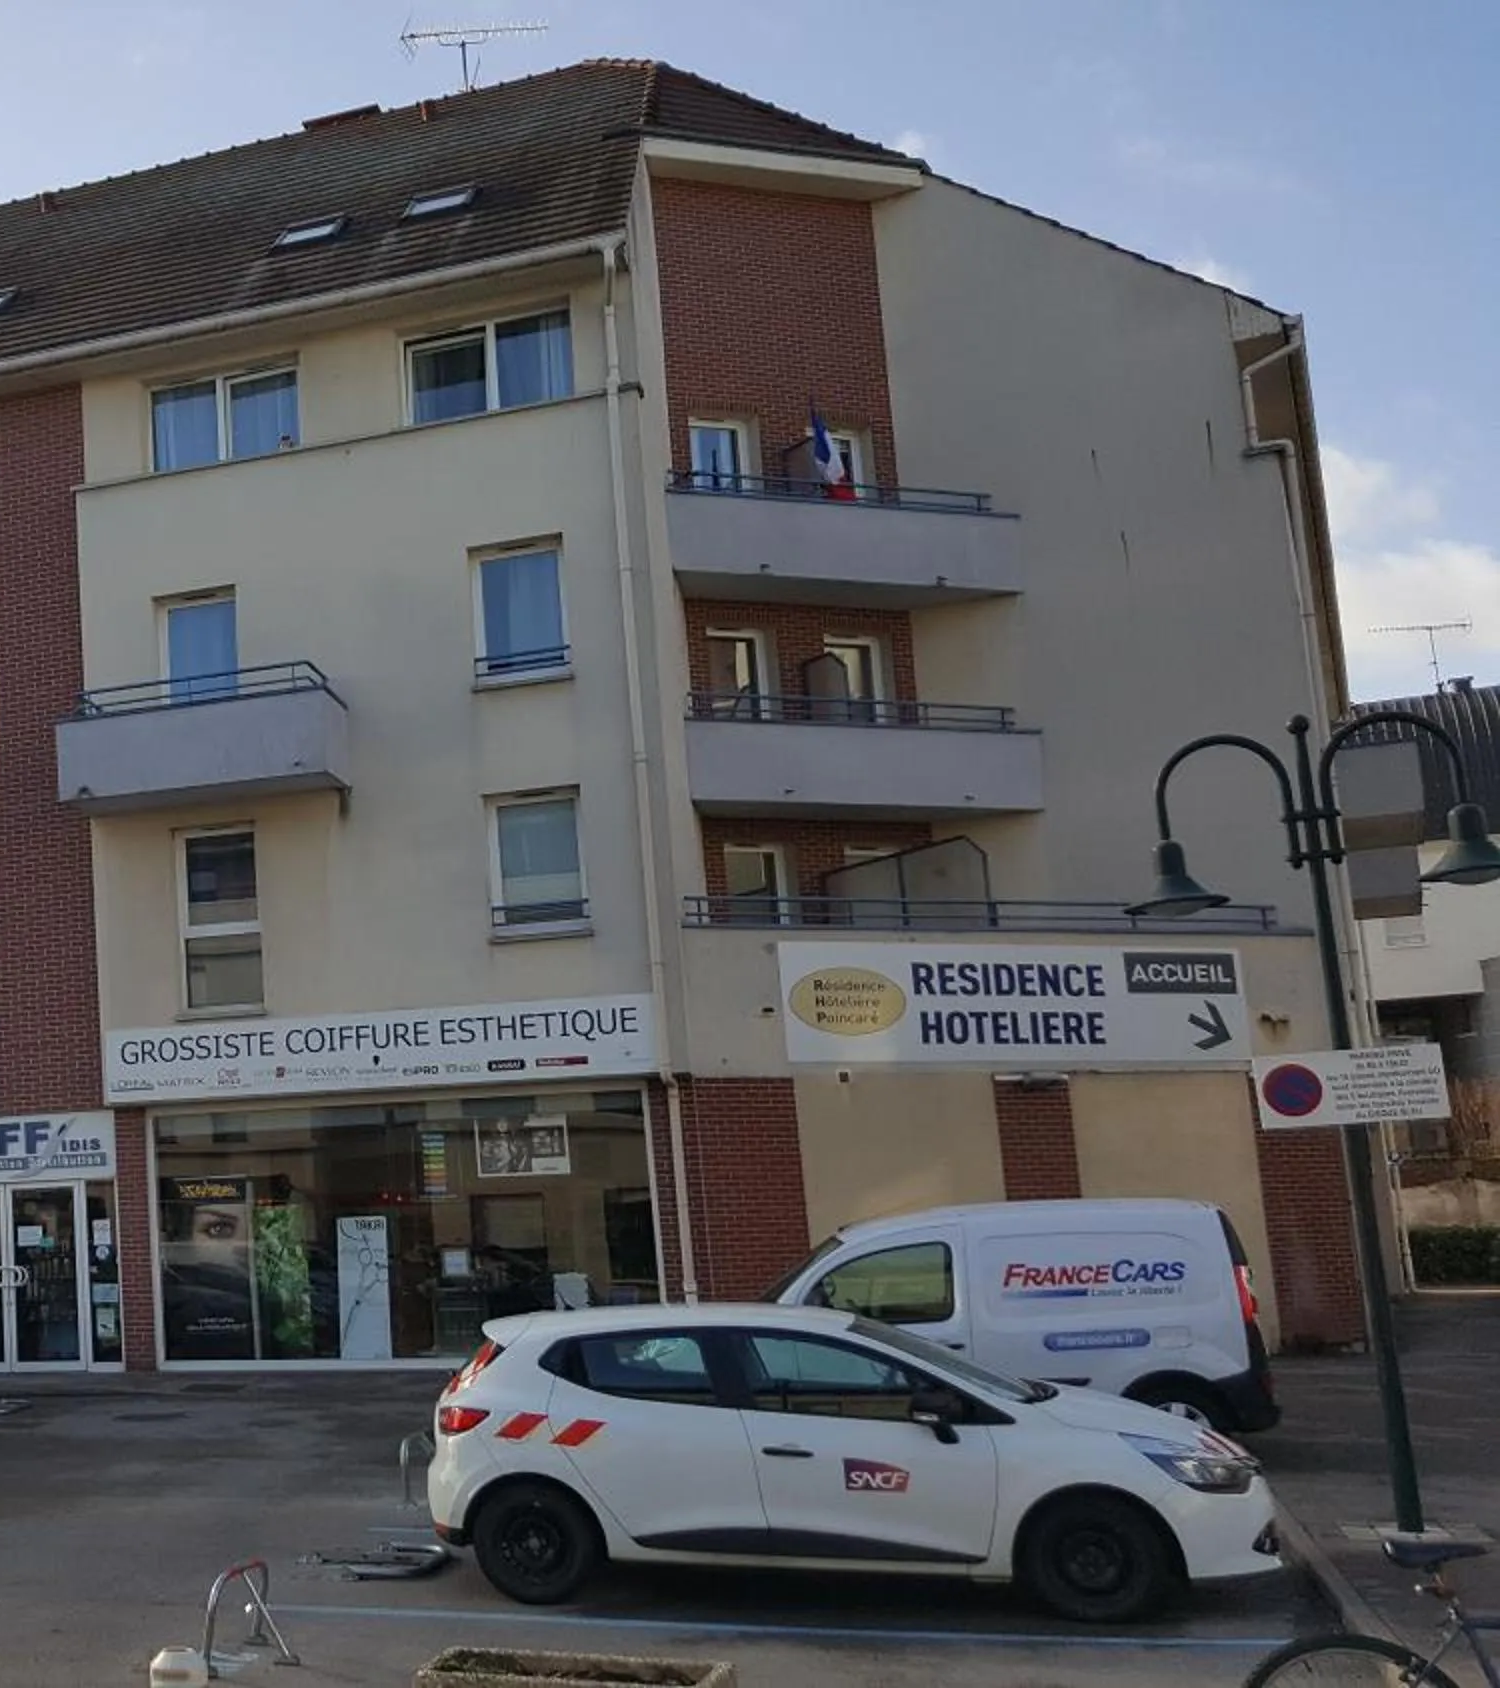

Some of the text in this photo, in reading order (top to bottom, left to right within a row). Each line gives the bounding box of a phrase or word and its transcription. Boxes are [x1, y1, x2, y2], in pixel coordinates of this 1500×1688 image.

[911, 961, 1106, 998] RESIDENCE
[1131, 961, 1234, 986] ACCUEIL
[120, 1006, 639, 1066] GROSSISTE COIFFURE ESTHETIQUE
[920, 1011, 1107, 1046] HOTELIERE
[847, 1471, 908, 1489] SNCF
